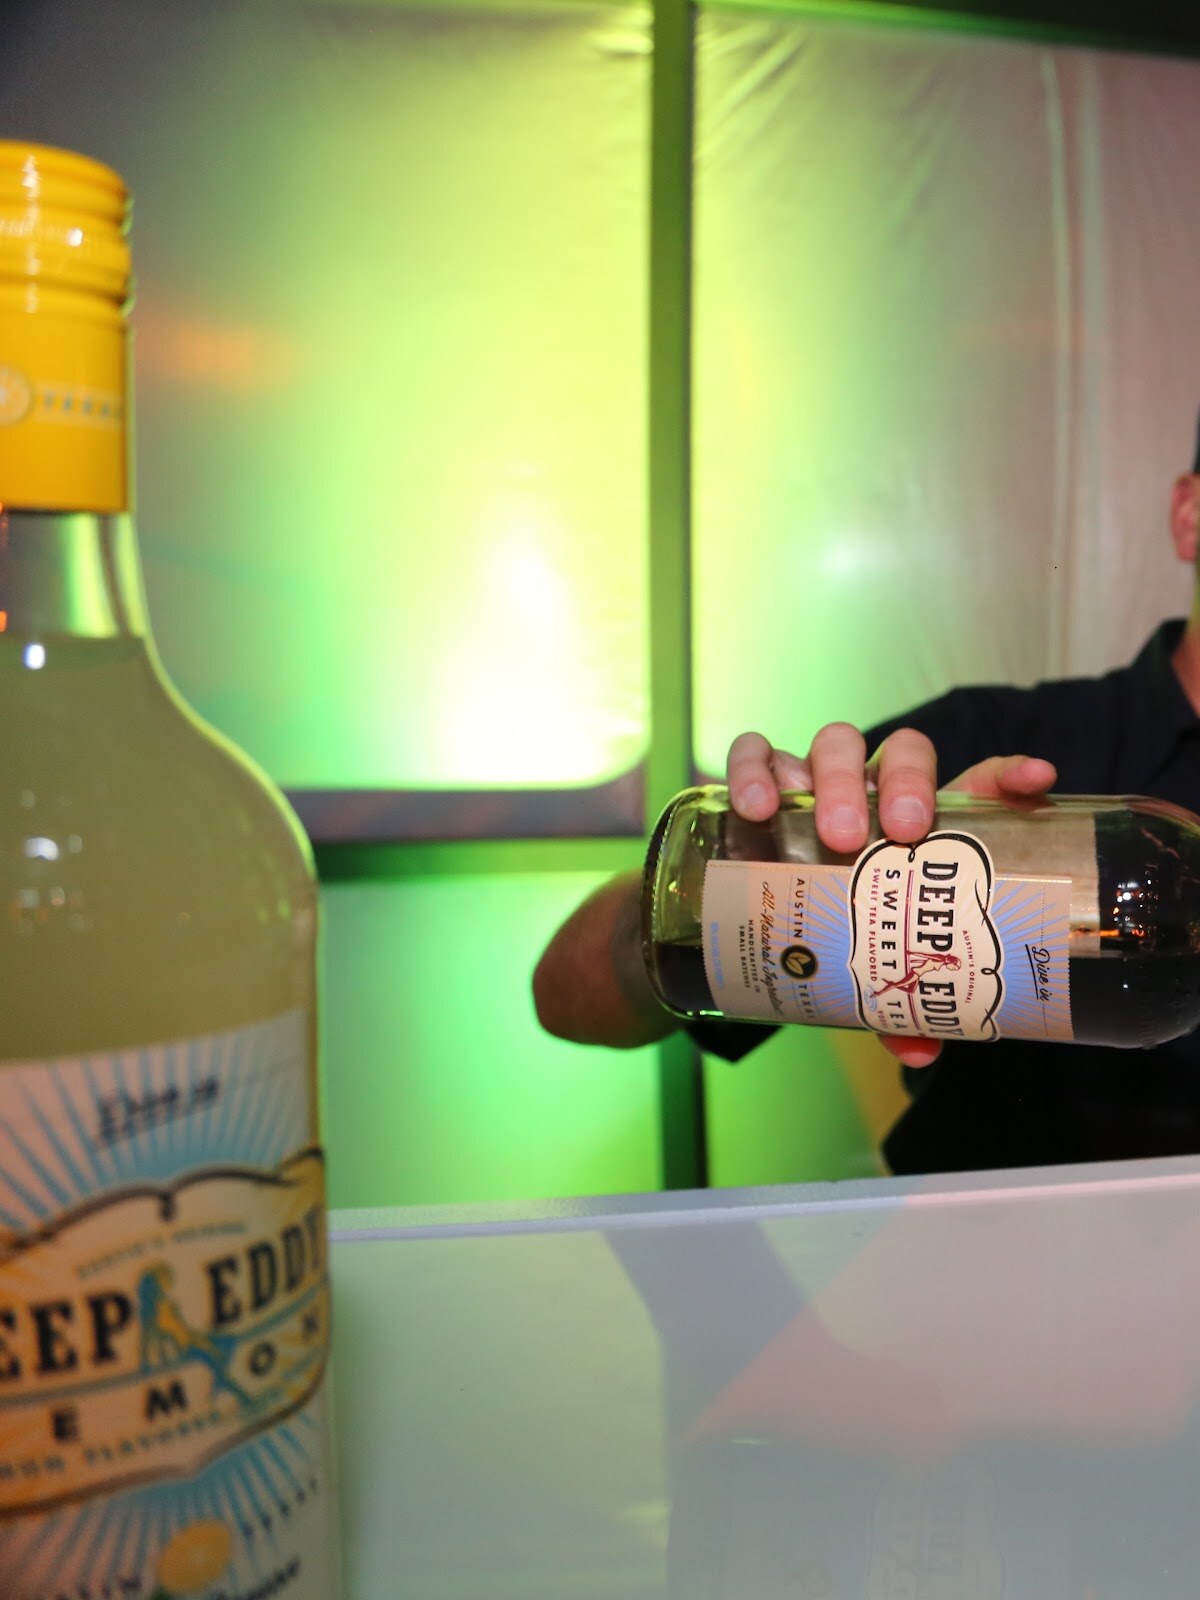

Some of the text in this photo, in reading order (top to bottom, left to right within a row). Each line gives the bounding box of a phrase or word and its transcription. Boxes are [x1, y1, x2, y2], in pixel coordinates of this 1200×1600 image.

[868, 907, 877, 926] TEA
[869, 867, 881, 905] SWEET
[738, 924, 747, 954] SMALL
[747, 919, 759, 984] HANDCRAFTED
[759, 881, 776, 967] All-Natural
[793, 878, 816, 1020] AUSTIN TEXAS
[868, 931, 878, 982] FLAVORED
[881, 869, 905, 1030] SWEET TEA
[916, 861, 965, 1037] DEEP EDDY
[961, 930, 975, 1004] AUSTIN'S ORIGINAL
[1031, 945, 1050, 1002] Dive in
